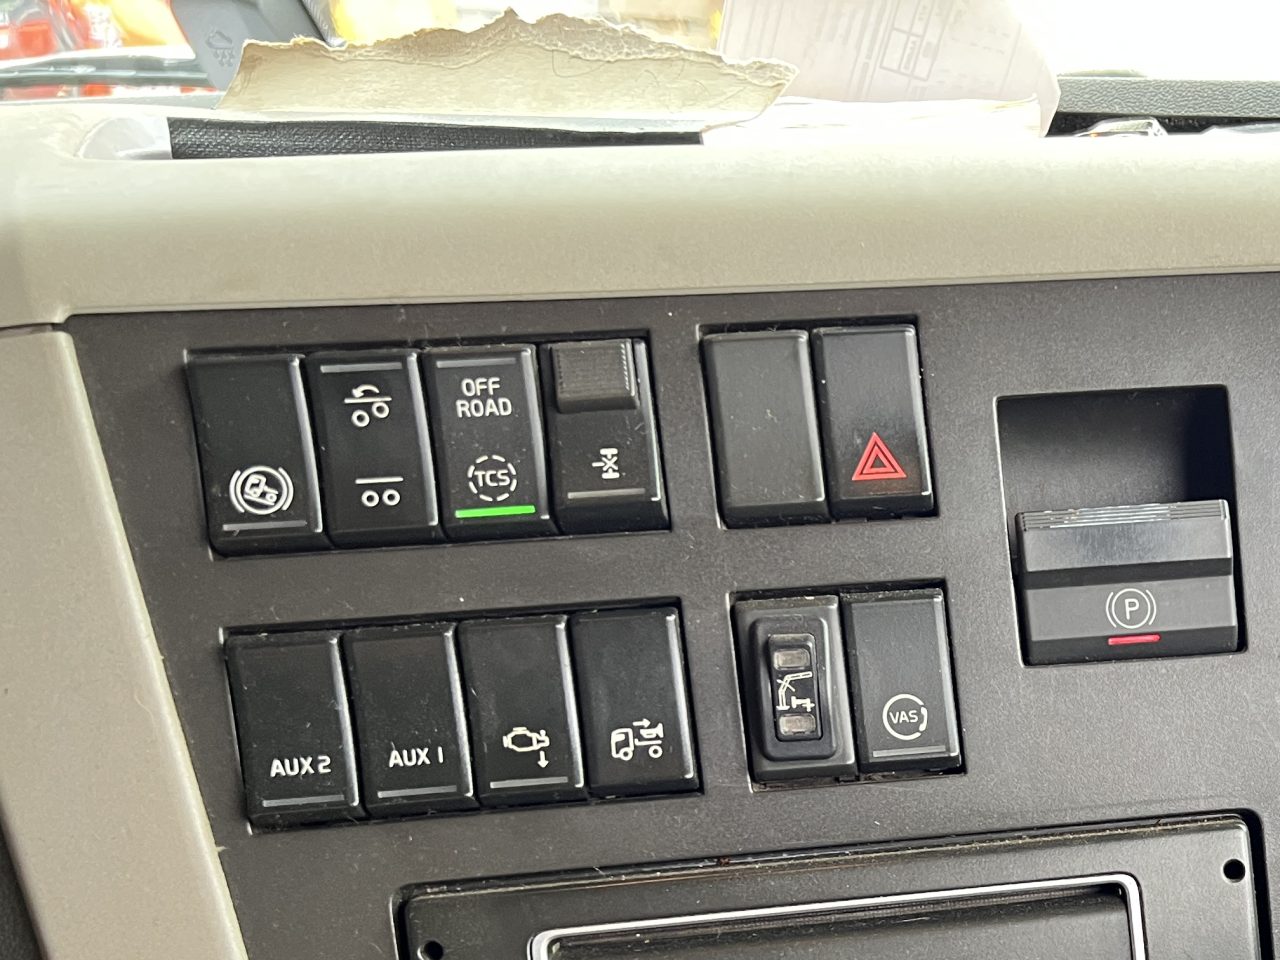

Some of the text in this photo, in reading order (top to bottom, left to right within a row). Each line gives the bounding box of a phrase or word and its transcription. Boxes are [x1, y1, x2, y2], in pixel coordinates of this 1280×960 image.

[462, 377, 500, 396] OFF
[456, 398, 512, 417] ROAD
[474, 470, 510, 487] TCS
[1125, 599, 1139, 620] P
[889, 710, 918, 724] VAS
[389, 746, 443, 767] AUX 1
[270, 756, 331, 777] AUX 2
